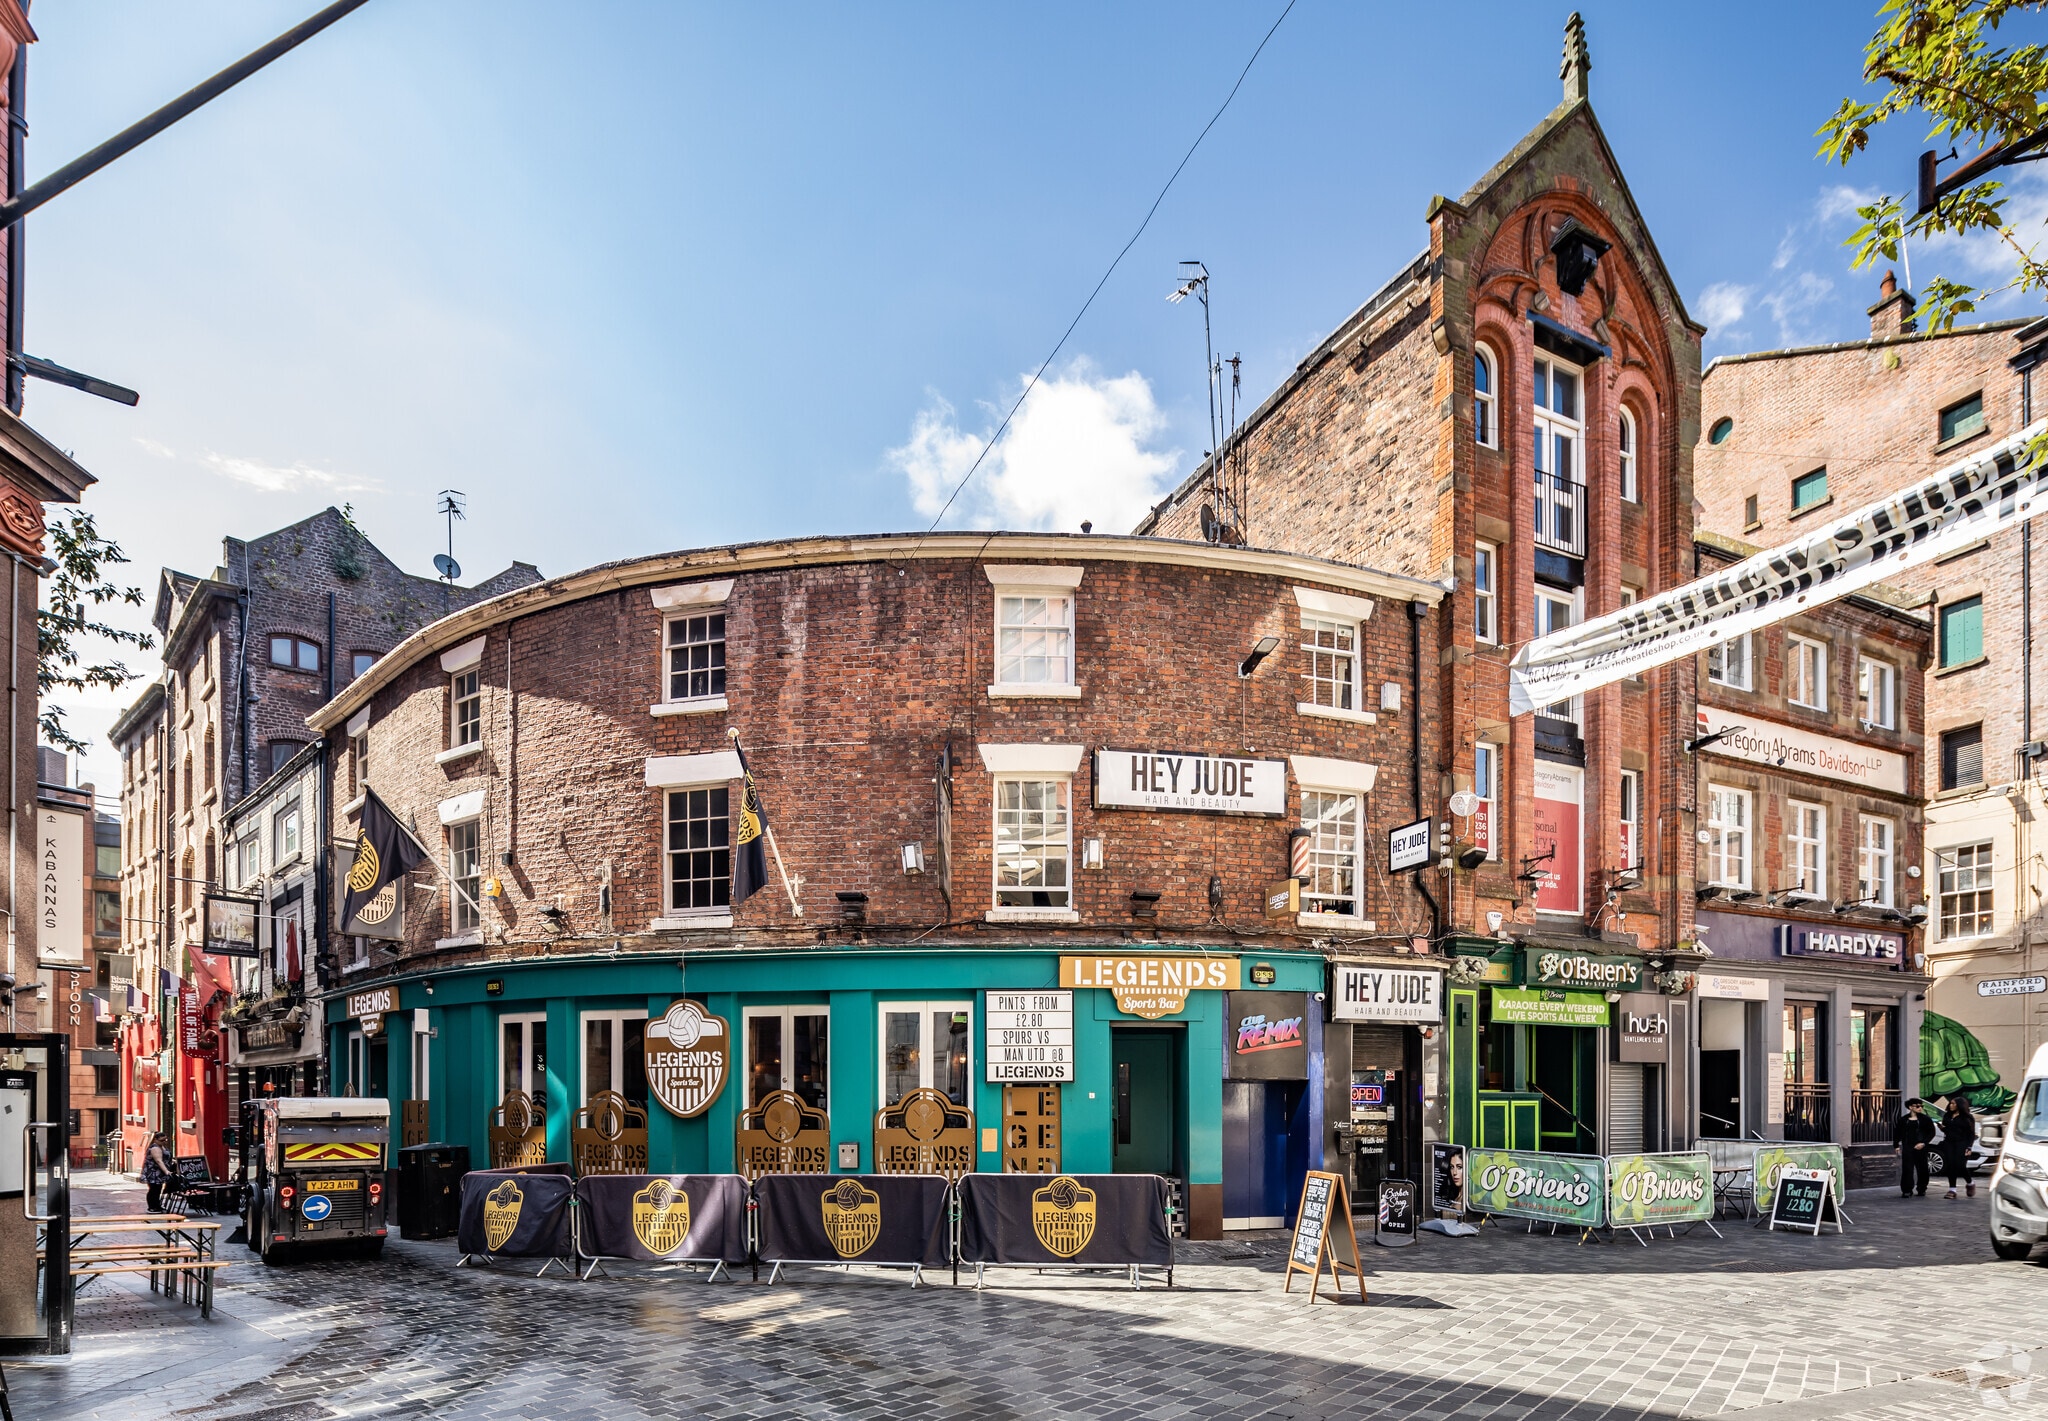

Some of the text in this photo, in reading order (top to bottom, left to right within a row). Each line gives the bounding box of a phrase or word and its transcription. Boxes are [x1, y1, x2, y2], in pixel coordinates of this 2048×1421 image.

[1819, 750, 1867, 778] Davidson
[1131, 755, 1254, 798] HEY JUDE
[1145, 795, 1241, 809] HAIR AND BEAUTY
[1392, 830, 1427, 854] HEY JUDE
[44, 838, 57, 929] KABANNAS
[1269, 890, 1289, 905] LEGENDS
[1809, 931, 1897, 959] HARDY'S
[1074, 959, 1227, 987] LEGENDS
[1345, 972, 1432, 1004] HEY JUDE
[1982, 978, 2042, 988] RAINFORD
[1989, 986, 2035, 995] SQUARE
[349, 989, 391, 1017] LEGENDS
[998, 996, 1058, 1010] PINTS FROM
[1123, 996, 1179, 1012] Sports Bar
[1499, 1000, 1606, 1014] KARAOKE EVERY WEEKEND
[1354, 1007, 1373, 1015] HAIR
[1394, 1008, 1423, 1016] BEAUTY
[1507, 1010, 1597, 1023] LIVE SPORTS ALL WEEK
[185, 993, 198, 1050] WALL OF FAME
[1015, 1013, 1043, 1027] £2.80
[1628, 1011, 1668, 1034] hush
[1003, 1030, 1050, 1044] SPURS VS
[1237, 1016, 1303, 1050] REMIX
[647, 1051, 723, 1068] LEGENDS
[1004, 1047, 1024, 1061] MAN
[1027, 1048, 1045, 1061] UTD
[995, 1065, 1065, 1079] LEGENDS
[670, 1079, 700, 1088] Sports Bar
[1351, 1087, 1381, 1101] OPEN
[492, 1141, 546, 1157] LEGENDS
[576, 1143, 646, 1160] LEGENDS
[742, 1146, 826, 1162] LEGENDS
[880, 1145, 970, 1162] LEGENDS
[310, 1181, 335, 1191] YJ23
[1480, 1164, 1591, 1206] O'Brien's
[1621, 1169, 1704, 1206] O'Brien's
[1384, 1187, 1409, 1200] Barber
[485, 1210, 518, 1221] LEGENDS
[635, 1212, 688, 1223] LEGENDS
[825, 1213, 878, 1224] LEGENDS
[1035, 1212, 1093, 1223] LEGENDS
